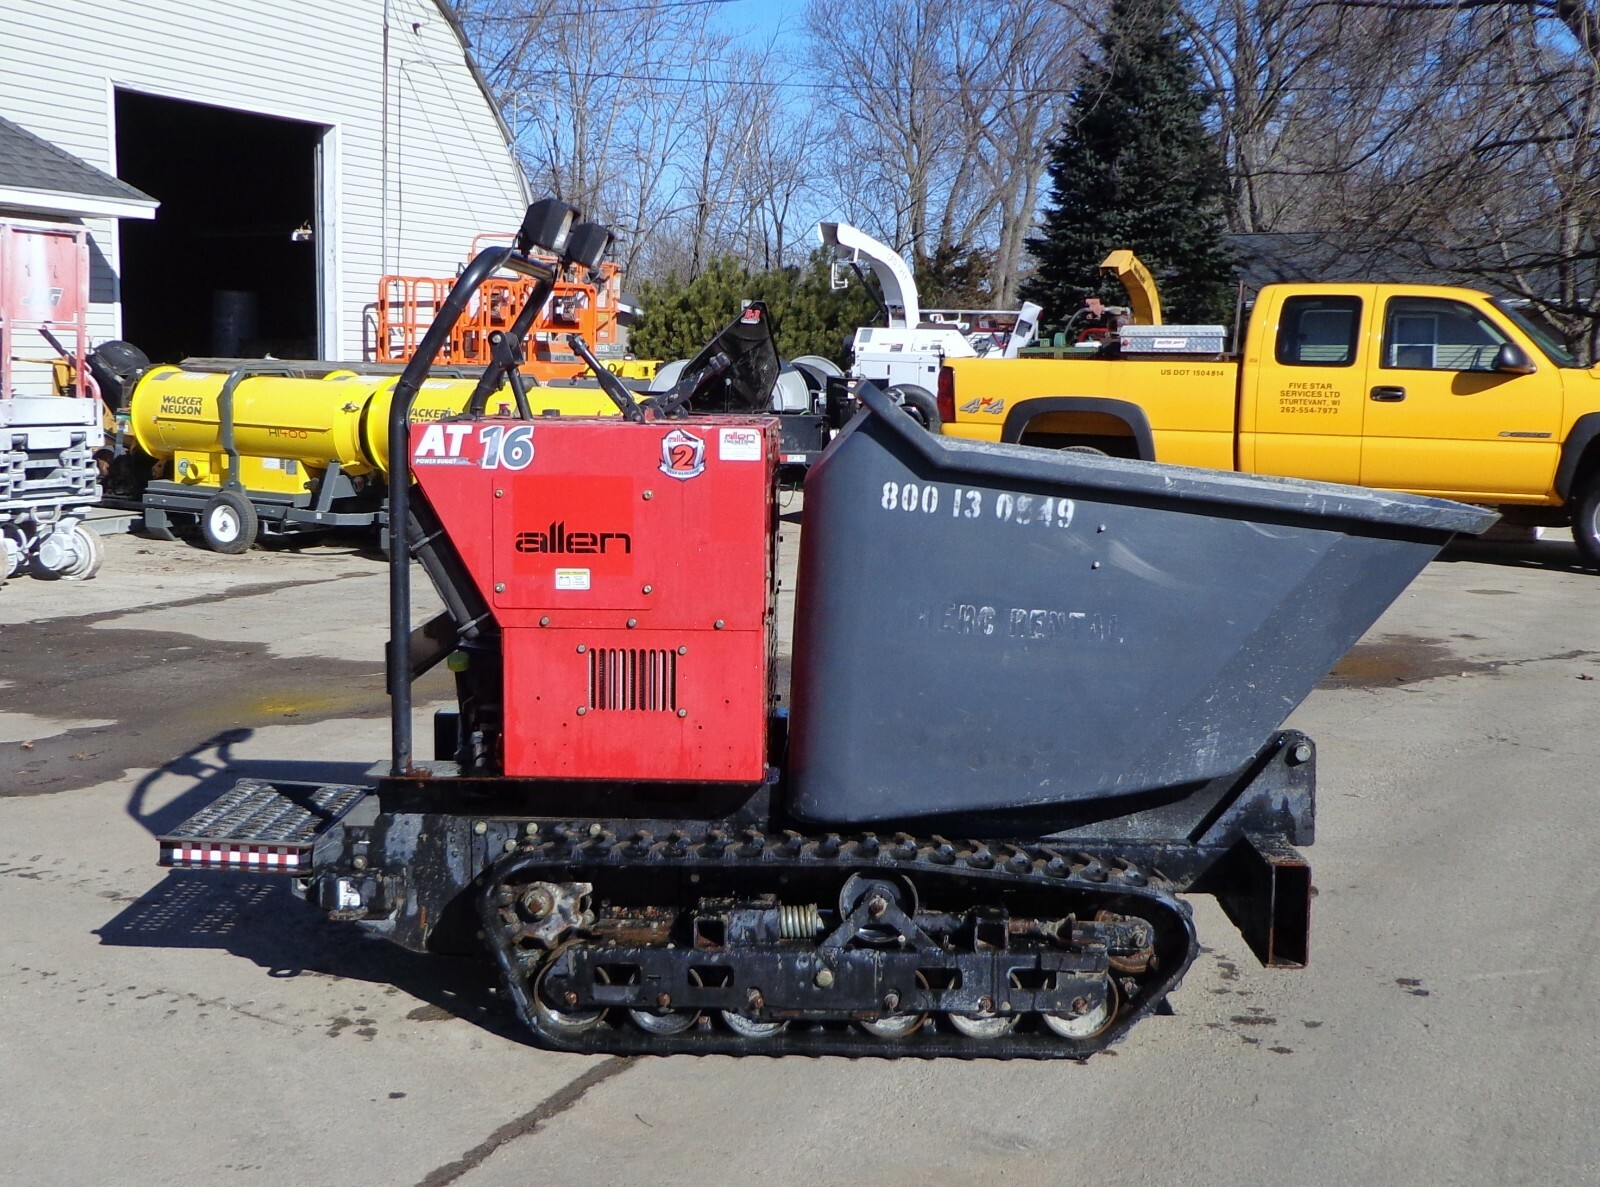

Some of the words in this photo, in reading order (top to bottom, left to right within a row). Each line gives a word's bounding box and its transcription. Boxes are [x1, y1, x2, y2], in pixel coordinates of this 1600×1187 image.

[1310, 382, 1332, 390] STAR
[162, 395, 203, 406] WACKER
[1279, 398, 1330, 406] STURTEVANT,
[160, 404, 202, 415] NEUSON
[1280, 406, 1338, 414] 262-554-7973
[414, 424, 474, 457] AT
[480, 425, 535, 471] 16
[672, 444, 695, 471] 2
[881, 481, 938, 514] 800
[952, 488, 982, 518] 13
[515, 520, 631, 554] allen
